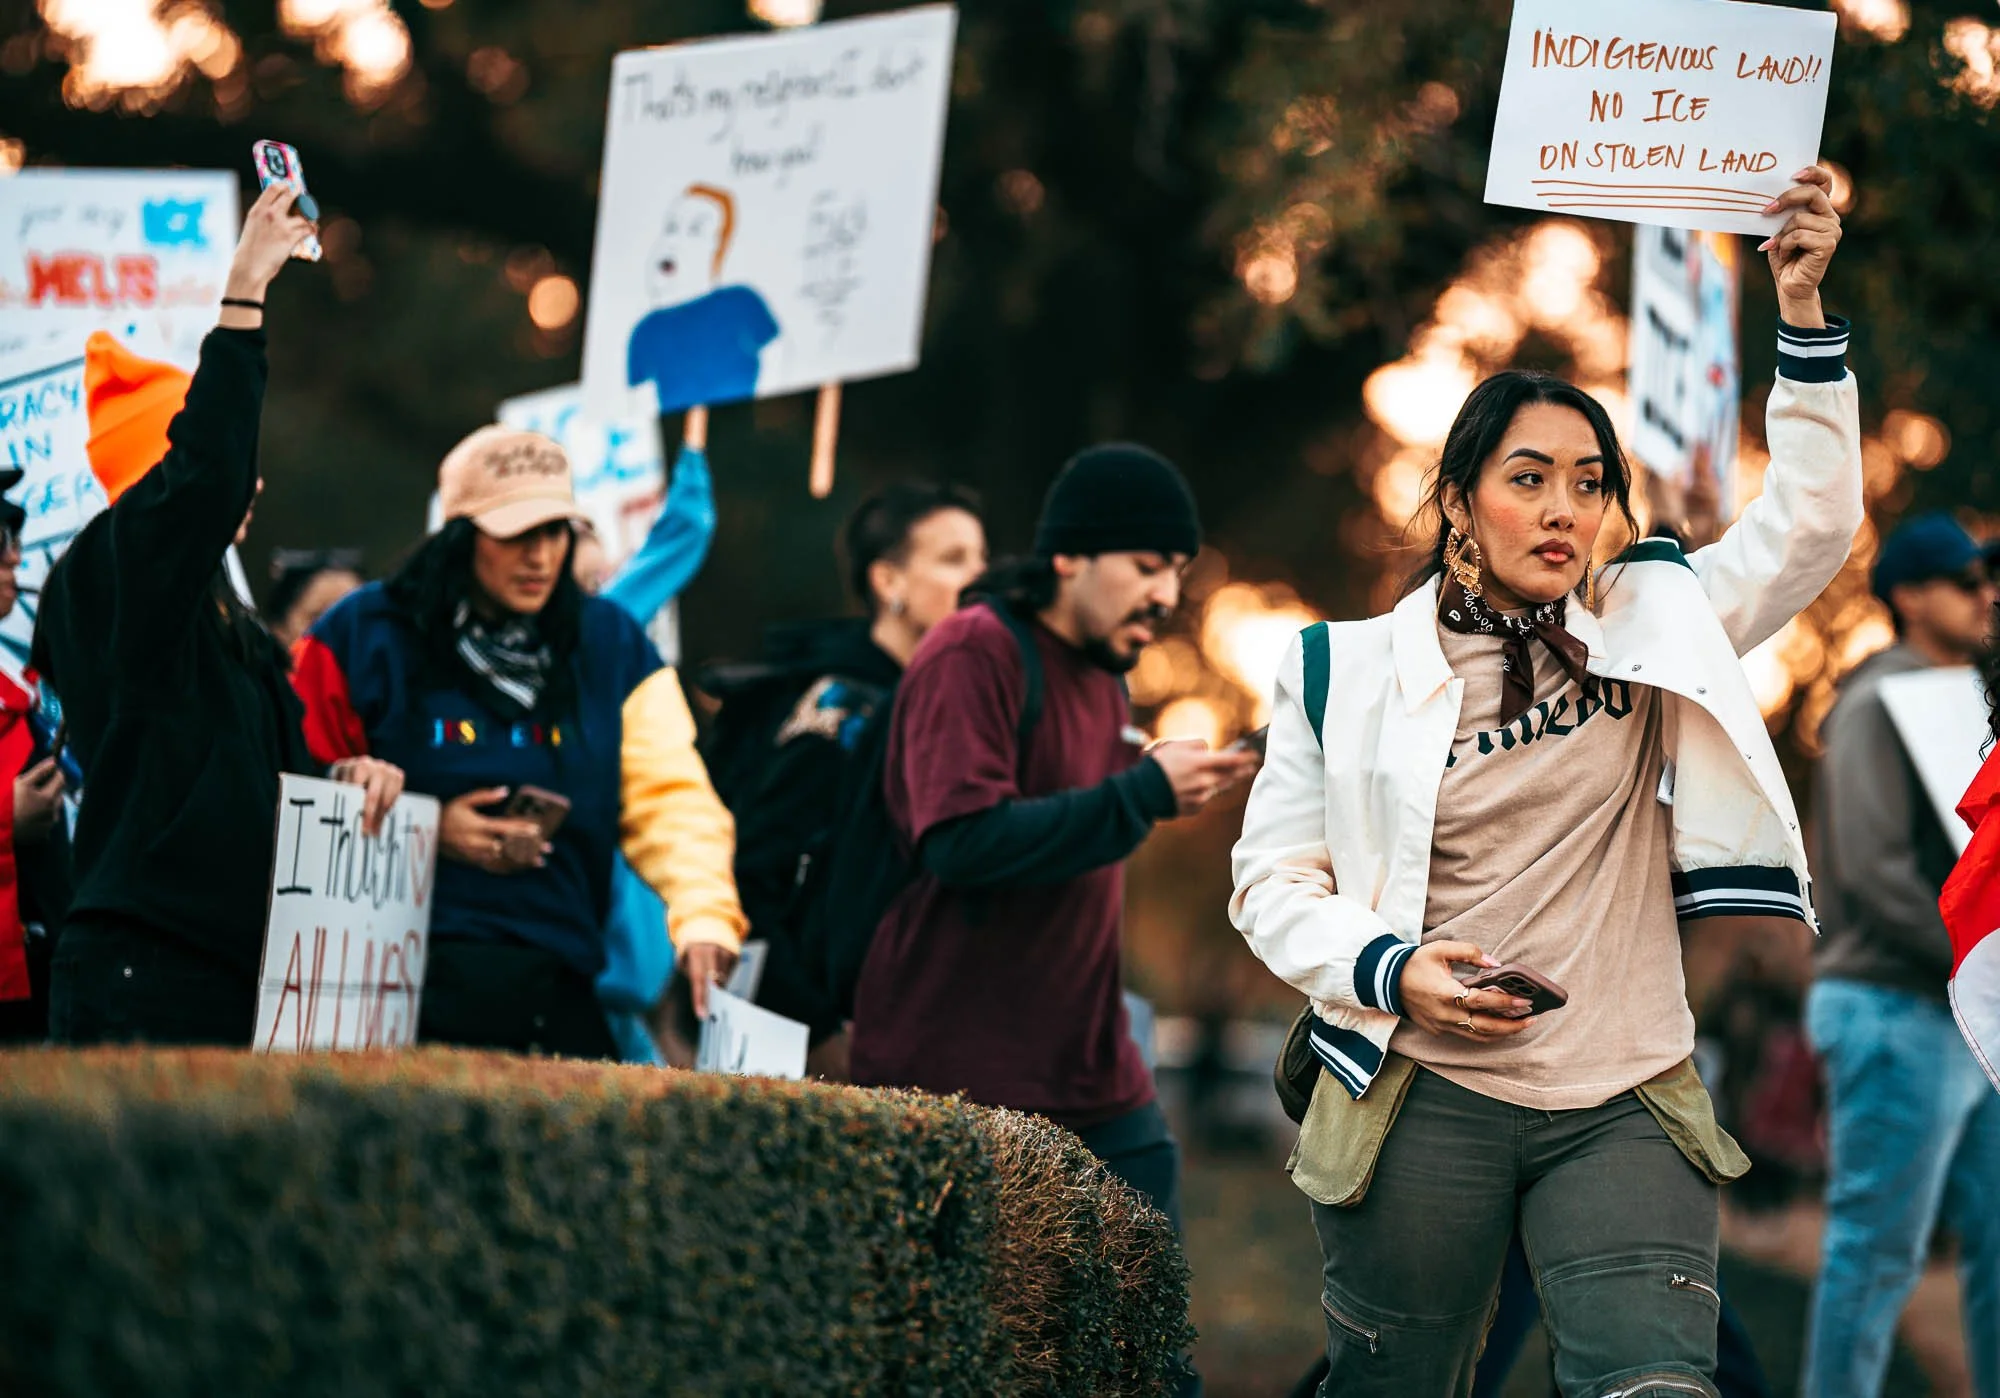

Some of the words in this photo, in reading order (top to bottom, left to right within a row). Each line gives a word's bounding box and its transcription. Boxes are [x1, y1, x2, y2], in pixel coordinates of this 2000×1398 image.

[1532, 28, 1718, 71] INDIGENOUS
[1737, 52, 1822, 83] LAND!!
[1590, 90, 1623, 122] NO
[1643, 89, 1710, 122] ICE
[1540, 141, 1578, 171] ON
[1586, 143, 1684, 172] STOLEN
[1699, 148, 1777, 173] LAND
[277, 796, 315, 895] I
